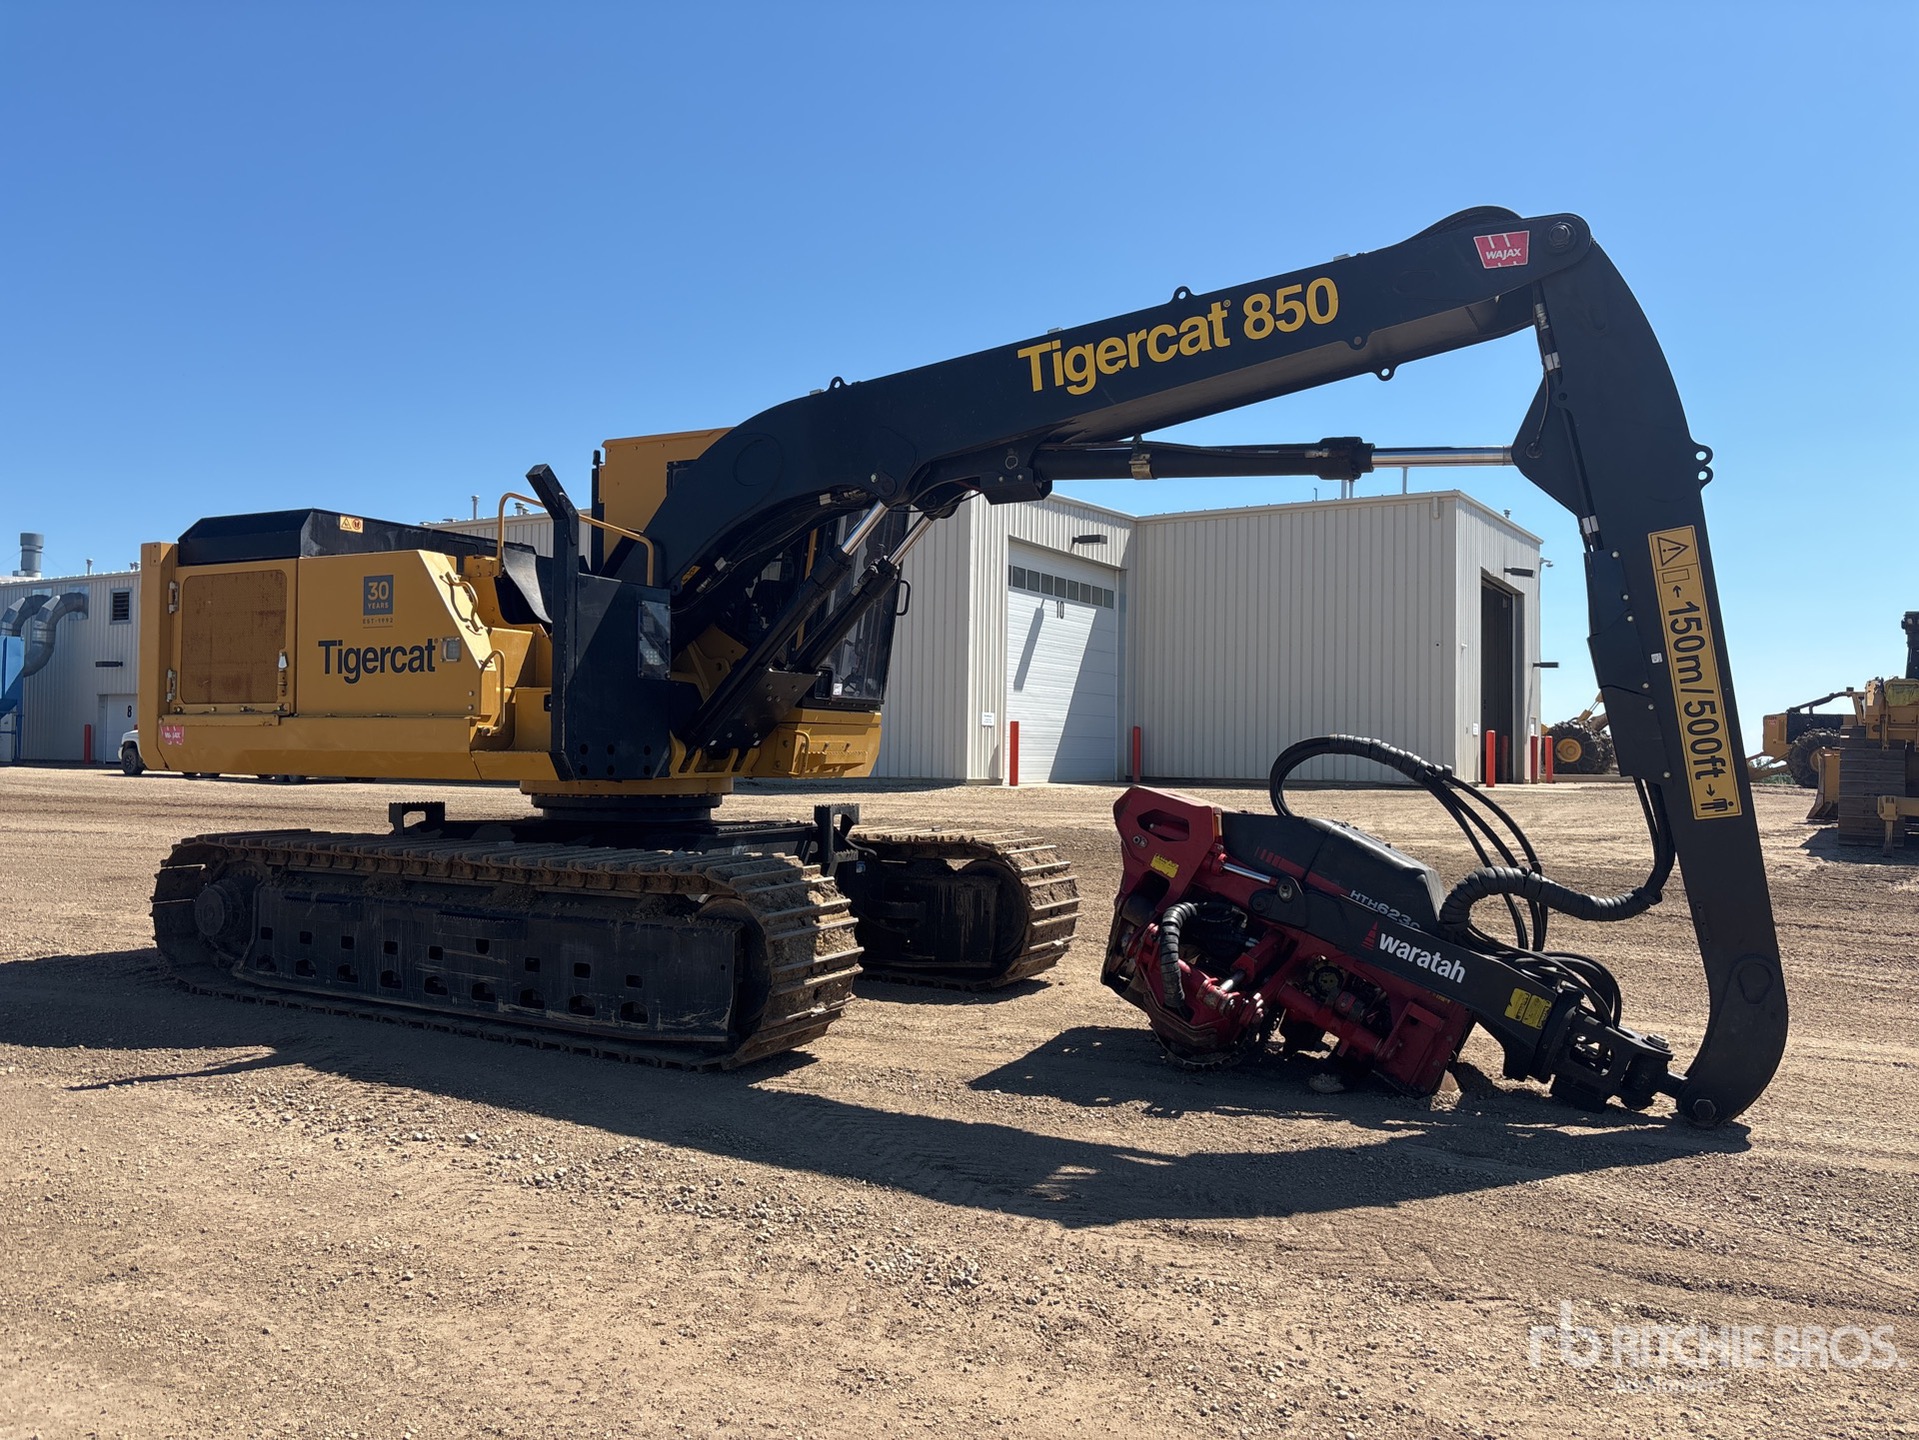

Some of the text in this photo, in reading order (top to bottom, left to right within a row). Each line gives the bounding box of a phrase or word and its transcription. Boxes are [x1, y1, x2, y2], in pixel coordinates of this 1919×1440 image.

[1485, 248, 1522, 261] WAJAX
[1017, 277, 1340, 395] Tigercat 850
[367, 581, 390, 601] 30
[367, 602, 389, 610] YEARS
[1056, 600, 1065, 620] 10
[317, 638, 436, 684] Tigercat
[126, 704, 133, 718] 8
[1379, 932, 1466, 984] waratah
